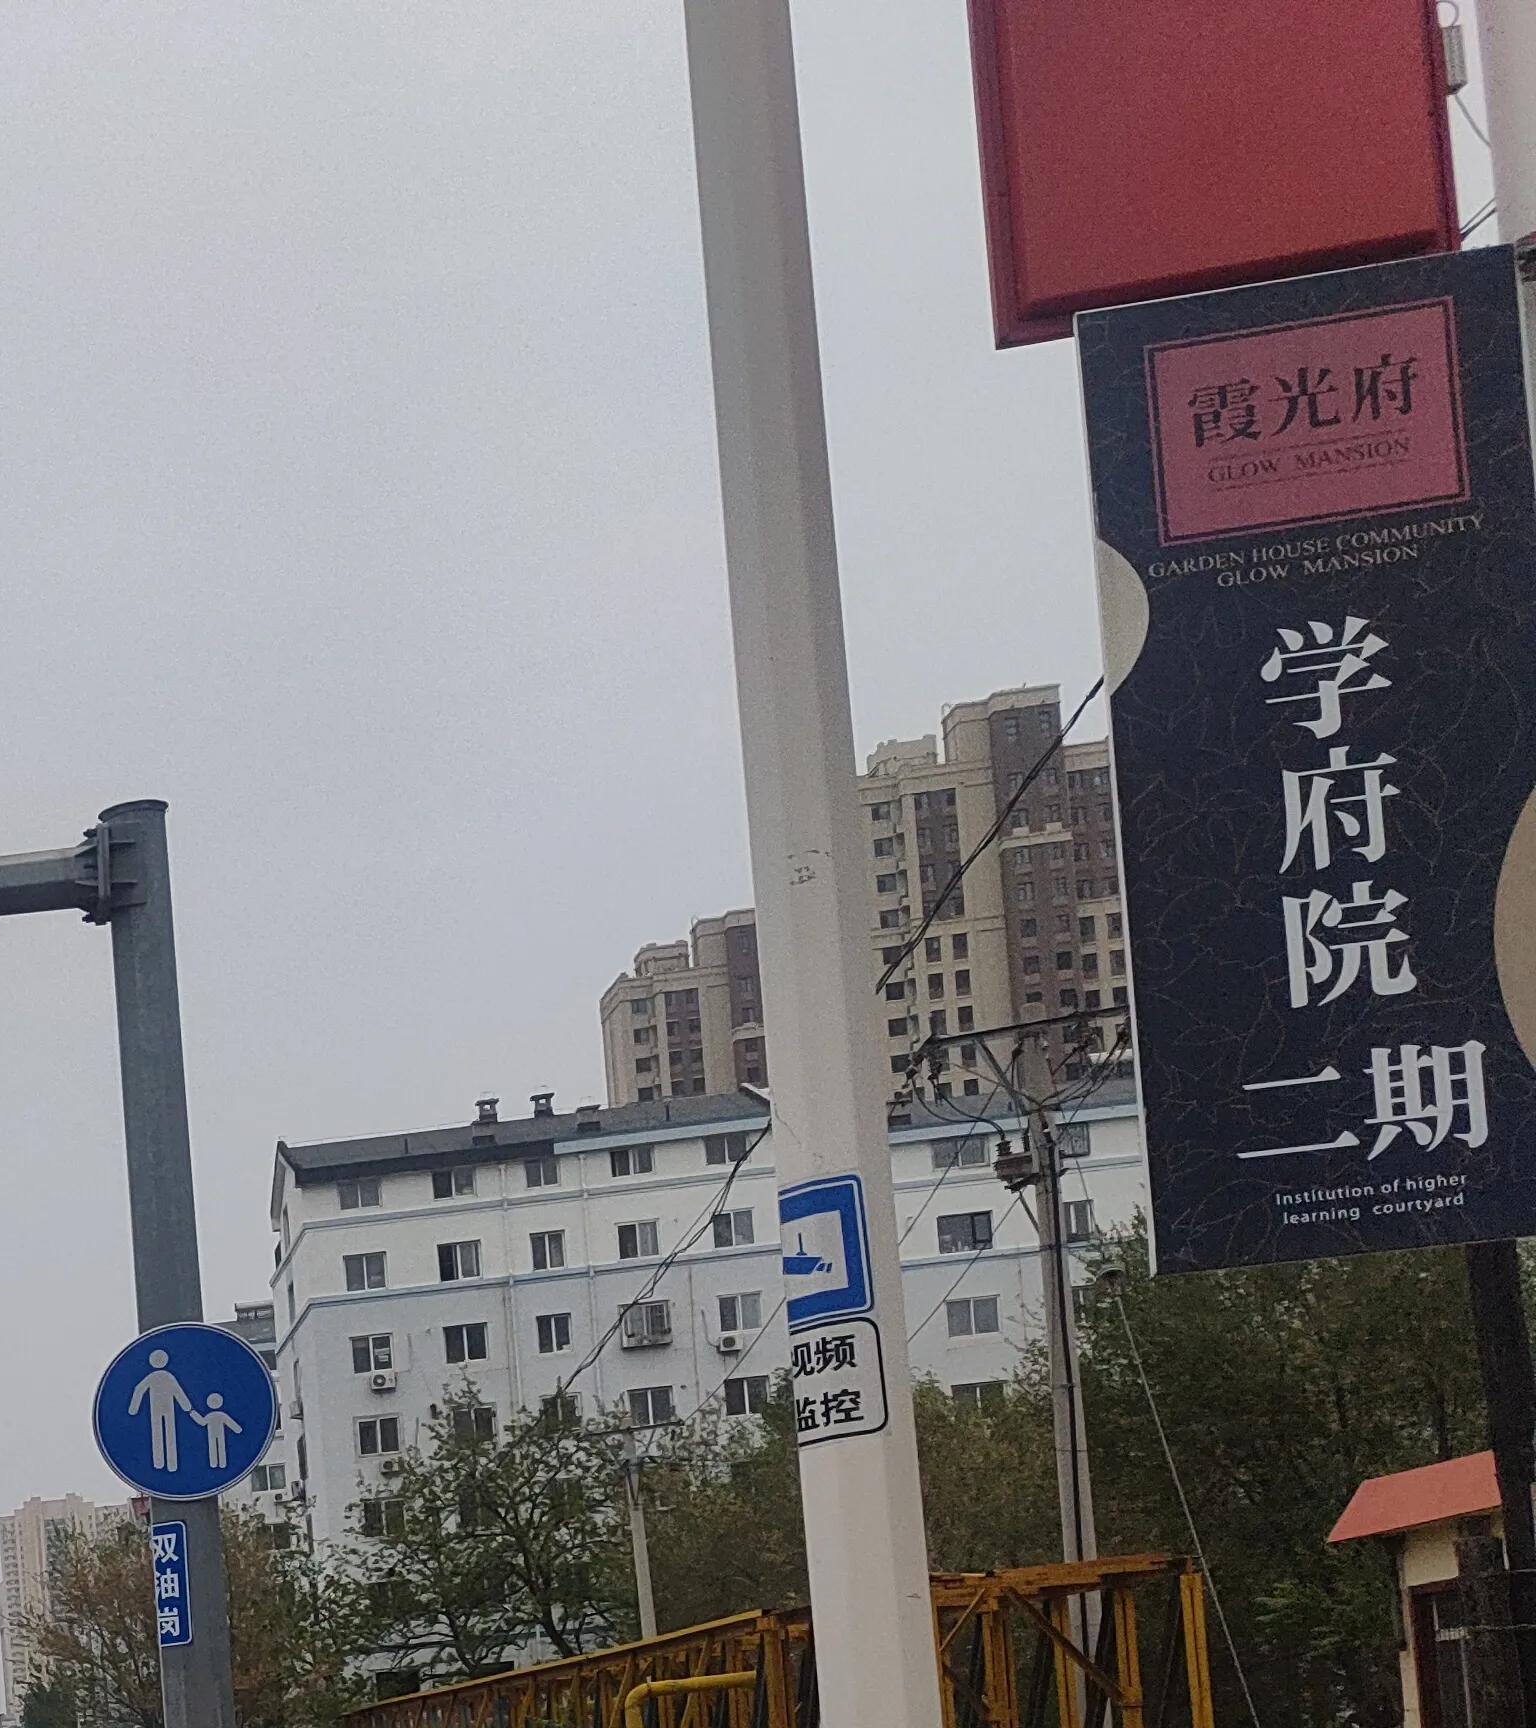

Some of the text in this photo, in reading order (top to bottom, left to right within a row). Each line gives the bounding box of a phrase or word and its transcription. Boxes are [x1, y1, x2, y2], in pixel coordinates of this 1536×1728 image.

[1187, 352, 1419, 449] 霞光府
[1207, 436, 1411, 484] GLOW MANSION
[1148, 512, 1485, 579] GARDEN HOUSE COMMUNITY
[1216, 544, 1419, 589] GLOW MANSION
[1259, 614, 1418, 1010] 学府院
[1236, 1038, 1490, 1162] 二期
[1275, 1174, 1468, 1206] Institution of higher
[1282, 1192, 1465, 1225] learning courtyard
[796, 1387, 865, 1433] 监控
[151, 1532, 181, 1638] 双油岗
